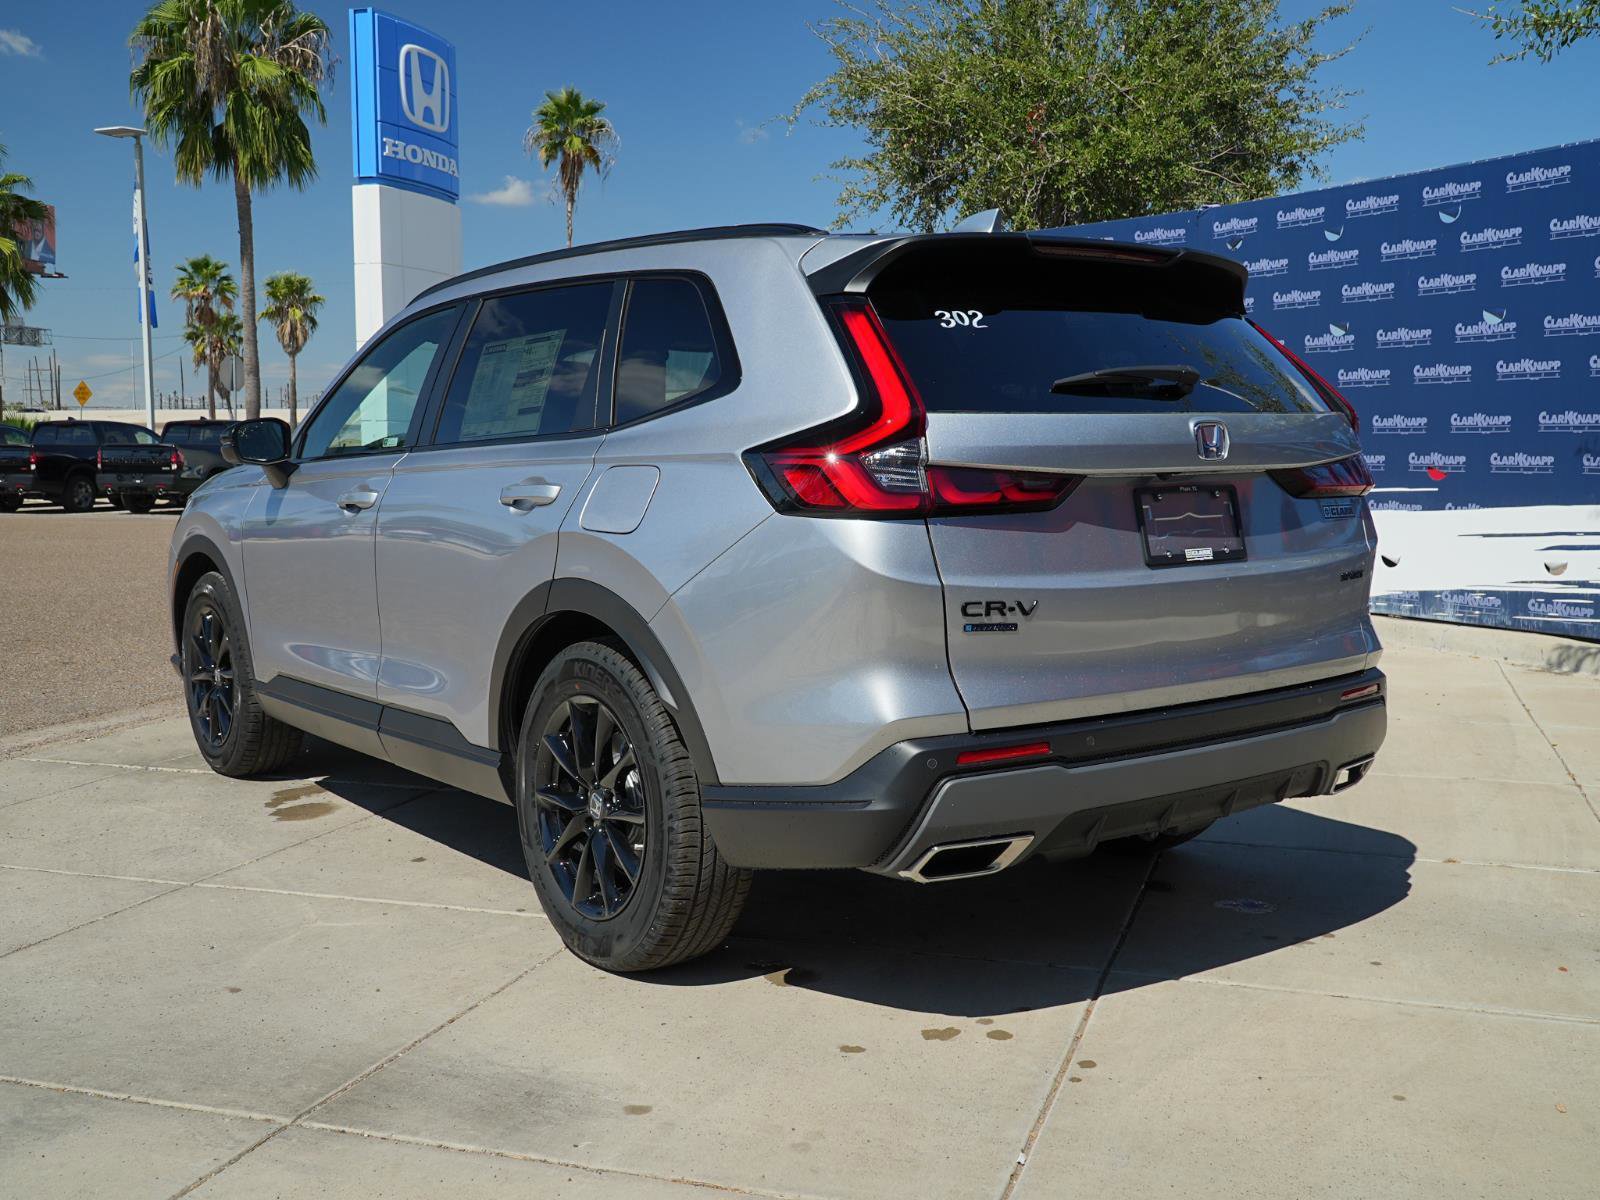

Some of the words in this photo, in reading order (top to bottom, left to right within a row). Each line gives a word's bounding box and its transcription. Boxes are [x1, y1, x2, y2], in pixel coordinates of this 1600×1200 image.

[383, 137, 459, 177] HONDA
[934, 310, 989, 328] 302
[961, 600, 1039, 617] CR-V
